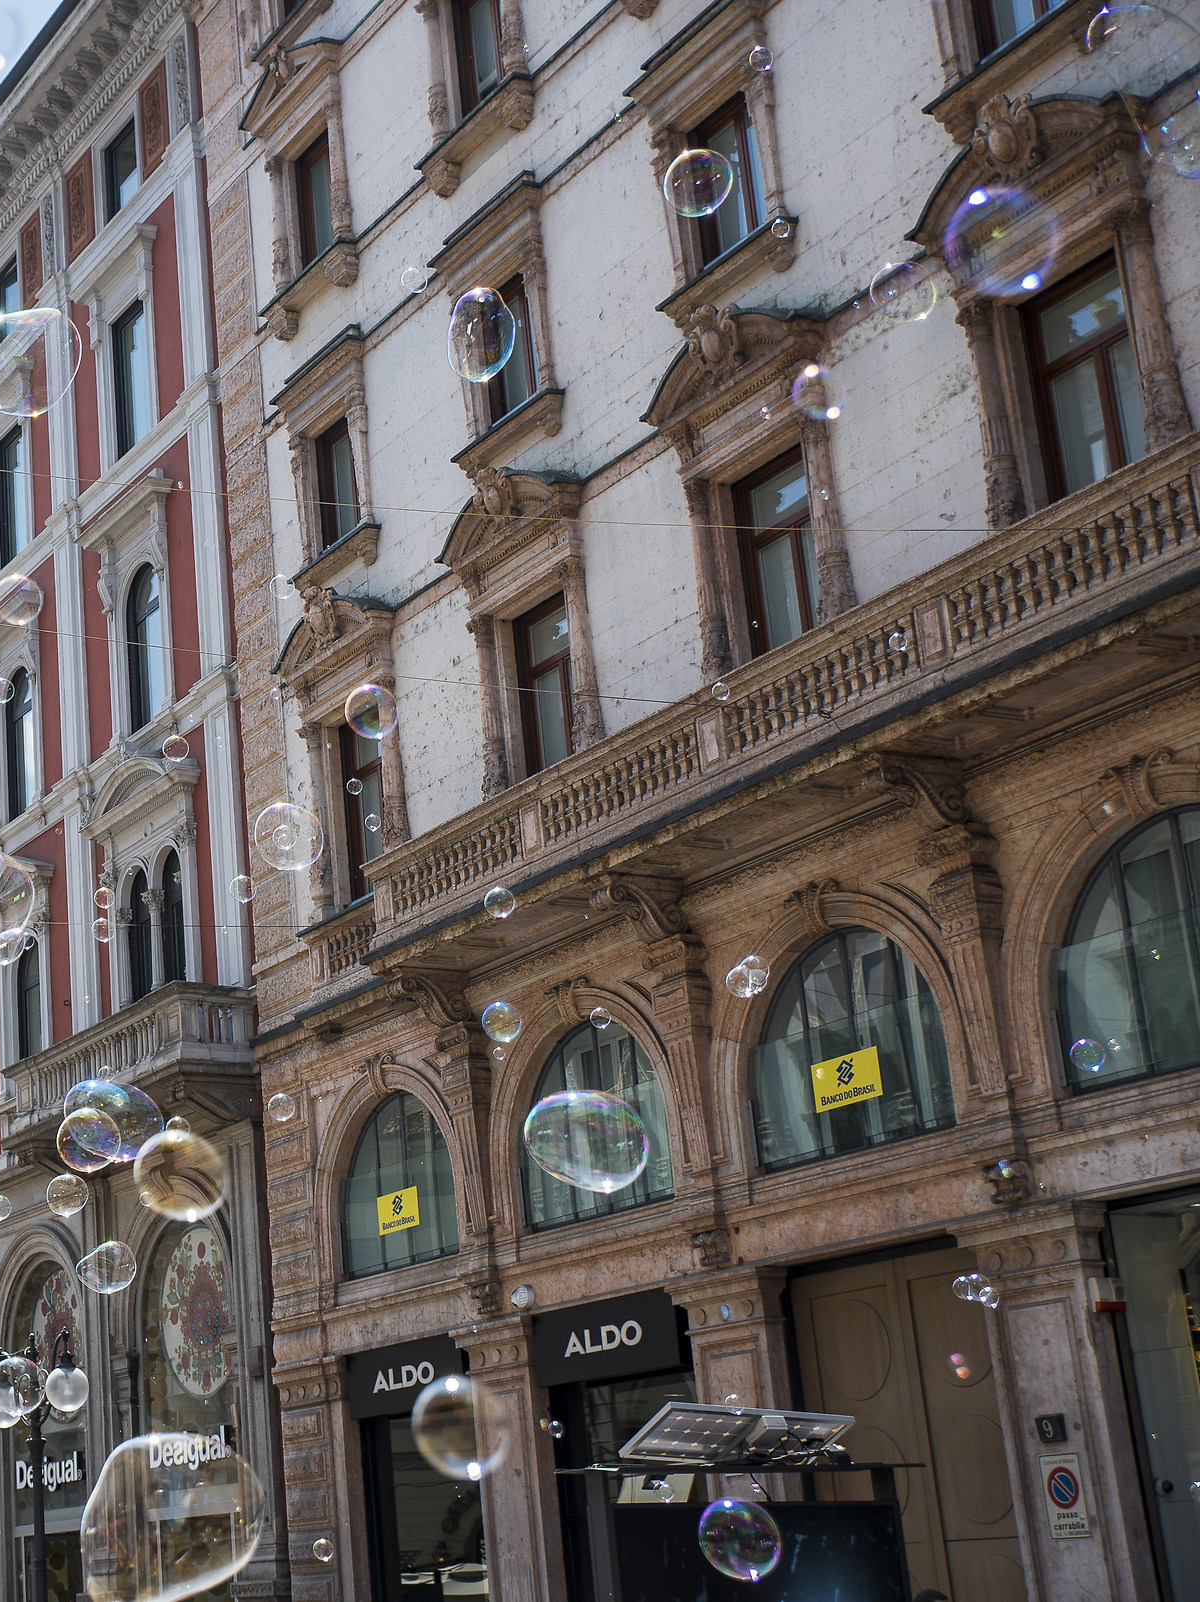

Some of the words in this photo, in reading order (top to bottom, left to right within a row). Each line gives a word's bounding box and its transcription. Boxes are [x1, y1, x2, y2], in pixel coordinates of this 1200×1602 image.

[821, 1092, 844, 1107] BANCO
[843, 1089, 853, 1100] DO
[852, 1083, 877, 1098] BRASIL
[564, 1320, 643, 1357] ALDO
[373, 1361, 434, 1394] ALDO
[1042, 1419, 1053, 1438] 9
[15, 1450, 78, 1492] Deigual
[1053, 1521, 1085, 1531] carrabile
[1056, 1512, 1078, 1521] passo
